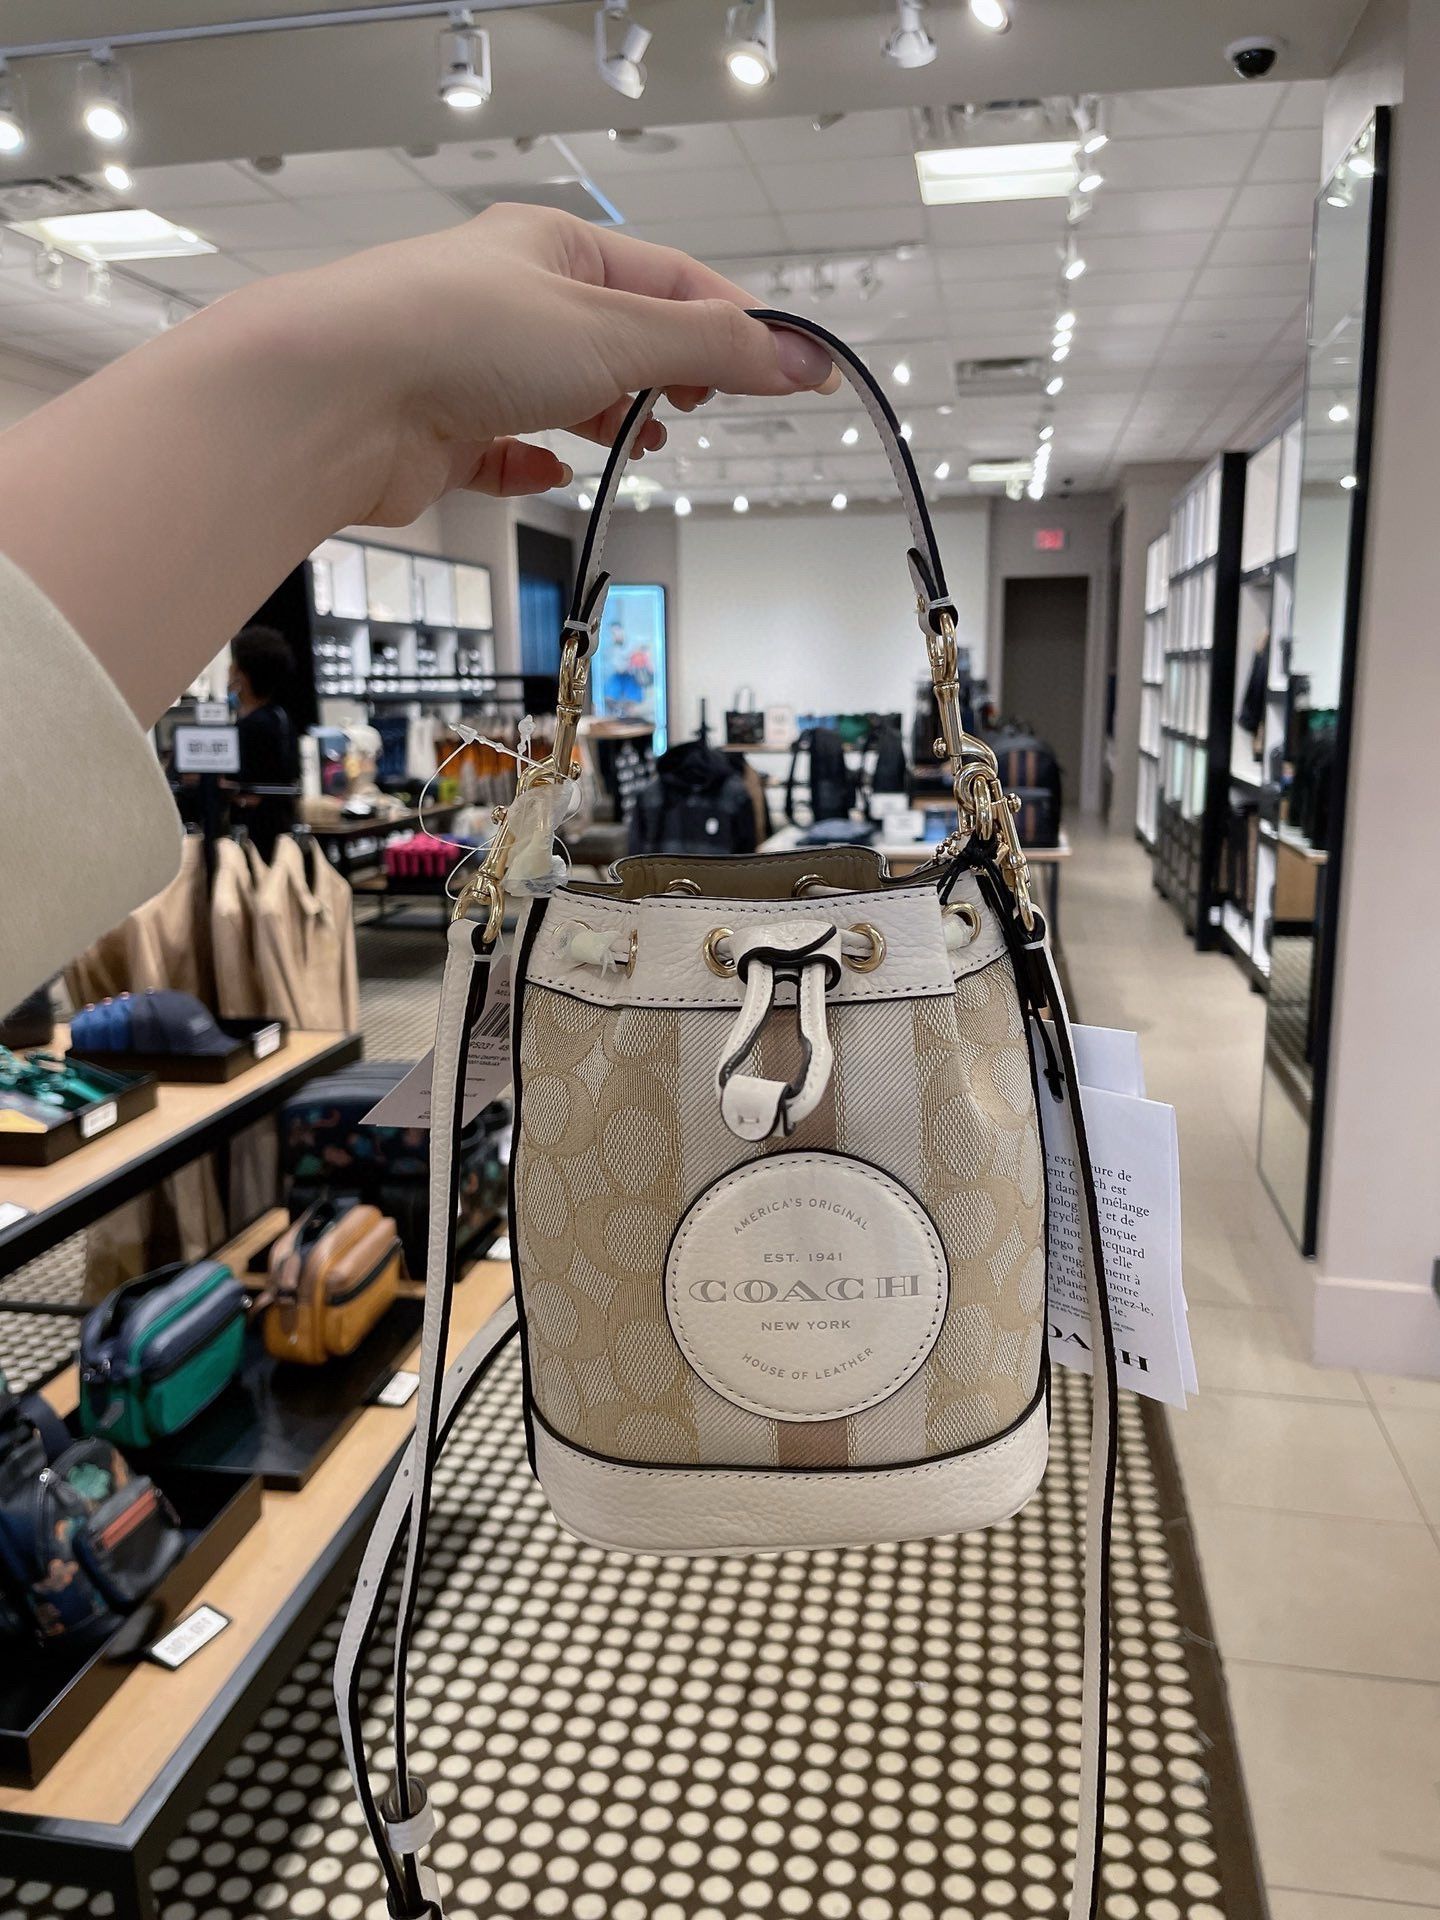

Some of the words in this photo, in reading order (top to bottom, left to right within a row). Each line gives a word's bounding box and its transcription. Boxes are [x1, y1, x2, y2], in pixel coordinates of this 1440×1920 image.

[1117, 1169, 1132, 1182] de
[1110, 1184, 1127, 1196] est
[1101, 1195, 1151, 1218] mélange
[734, 1198, 802, 1235] AMERICA'S
[808, 1198, 868, 1231] ORIGINAL
[1106, 1212, 1117, 1222] et
[1120, 1214, 1135, 1227] de
[1101, 1223, 1137, 1242] onçue
[764, 1253, 799, 1263] EST.
[808, 1252, 842, 1262] 1941
[1112, 1256, 1134, 1270] elle
[688, 1274, 921, 1304] COACH
[1109, 1282, 1139, 1298] notre
[1108, 1294, 1154, 1317] ortez-le,
[761, 1321, 800, 1331] NEW
[807, 1320, 851, 1330] YORK
[742, 1353, 786, 1379] HOUSE
[791, 1370, 809, 1380] OF
[815, 1347, 874, 1380] LEATHER
